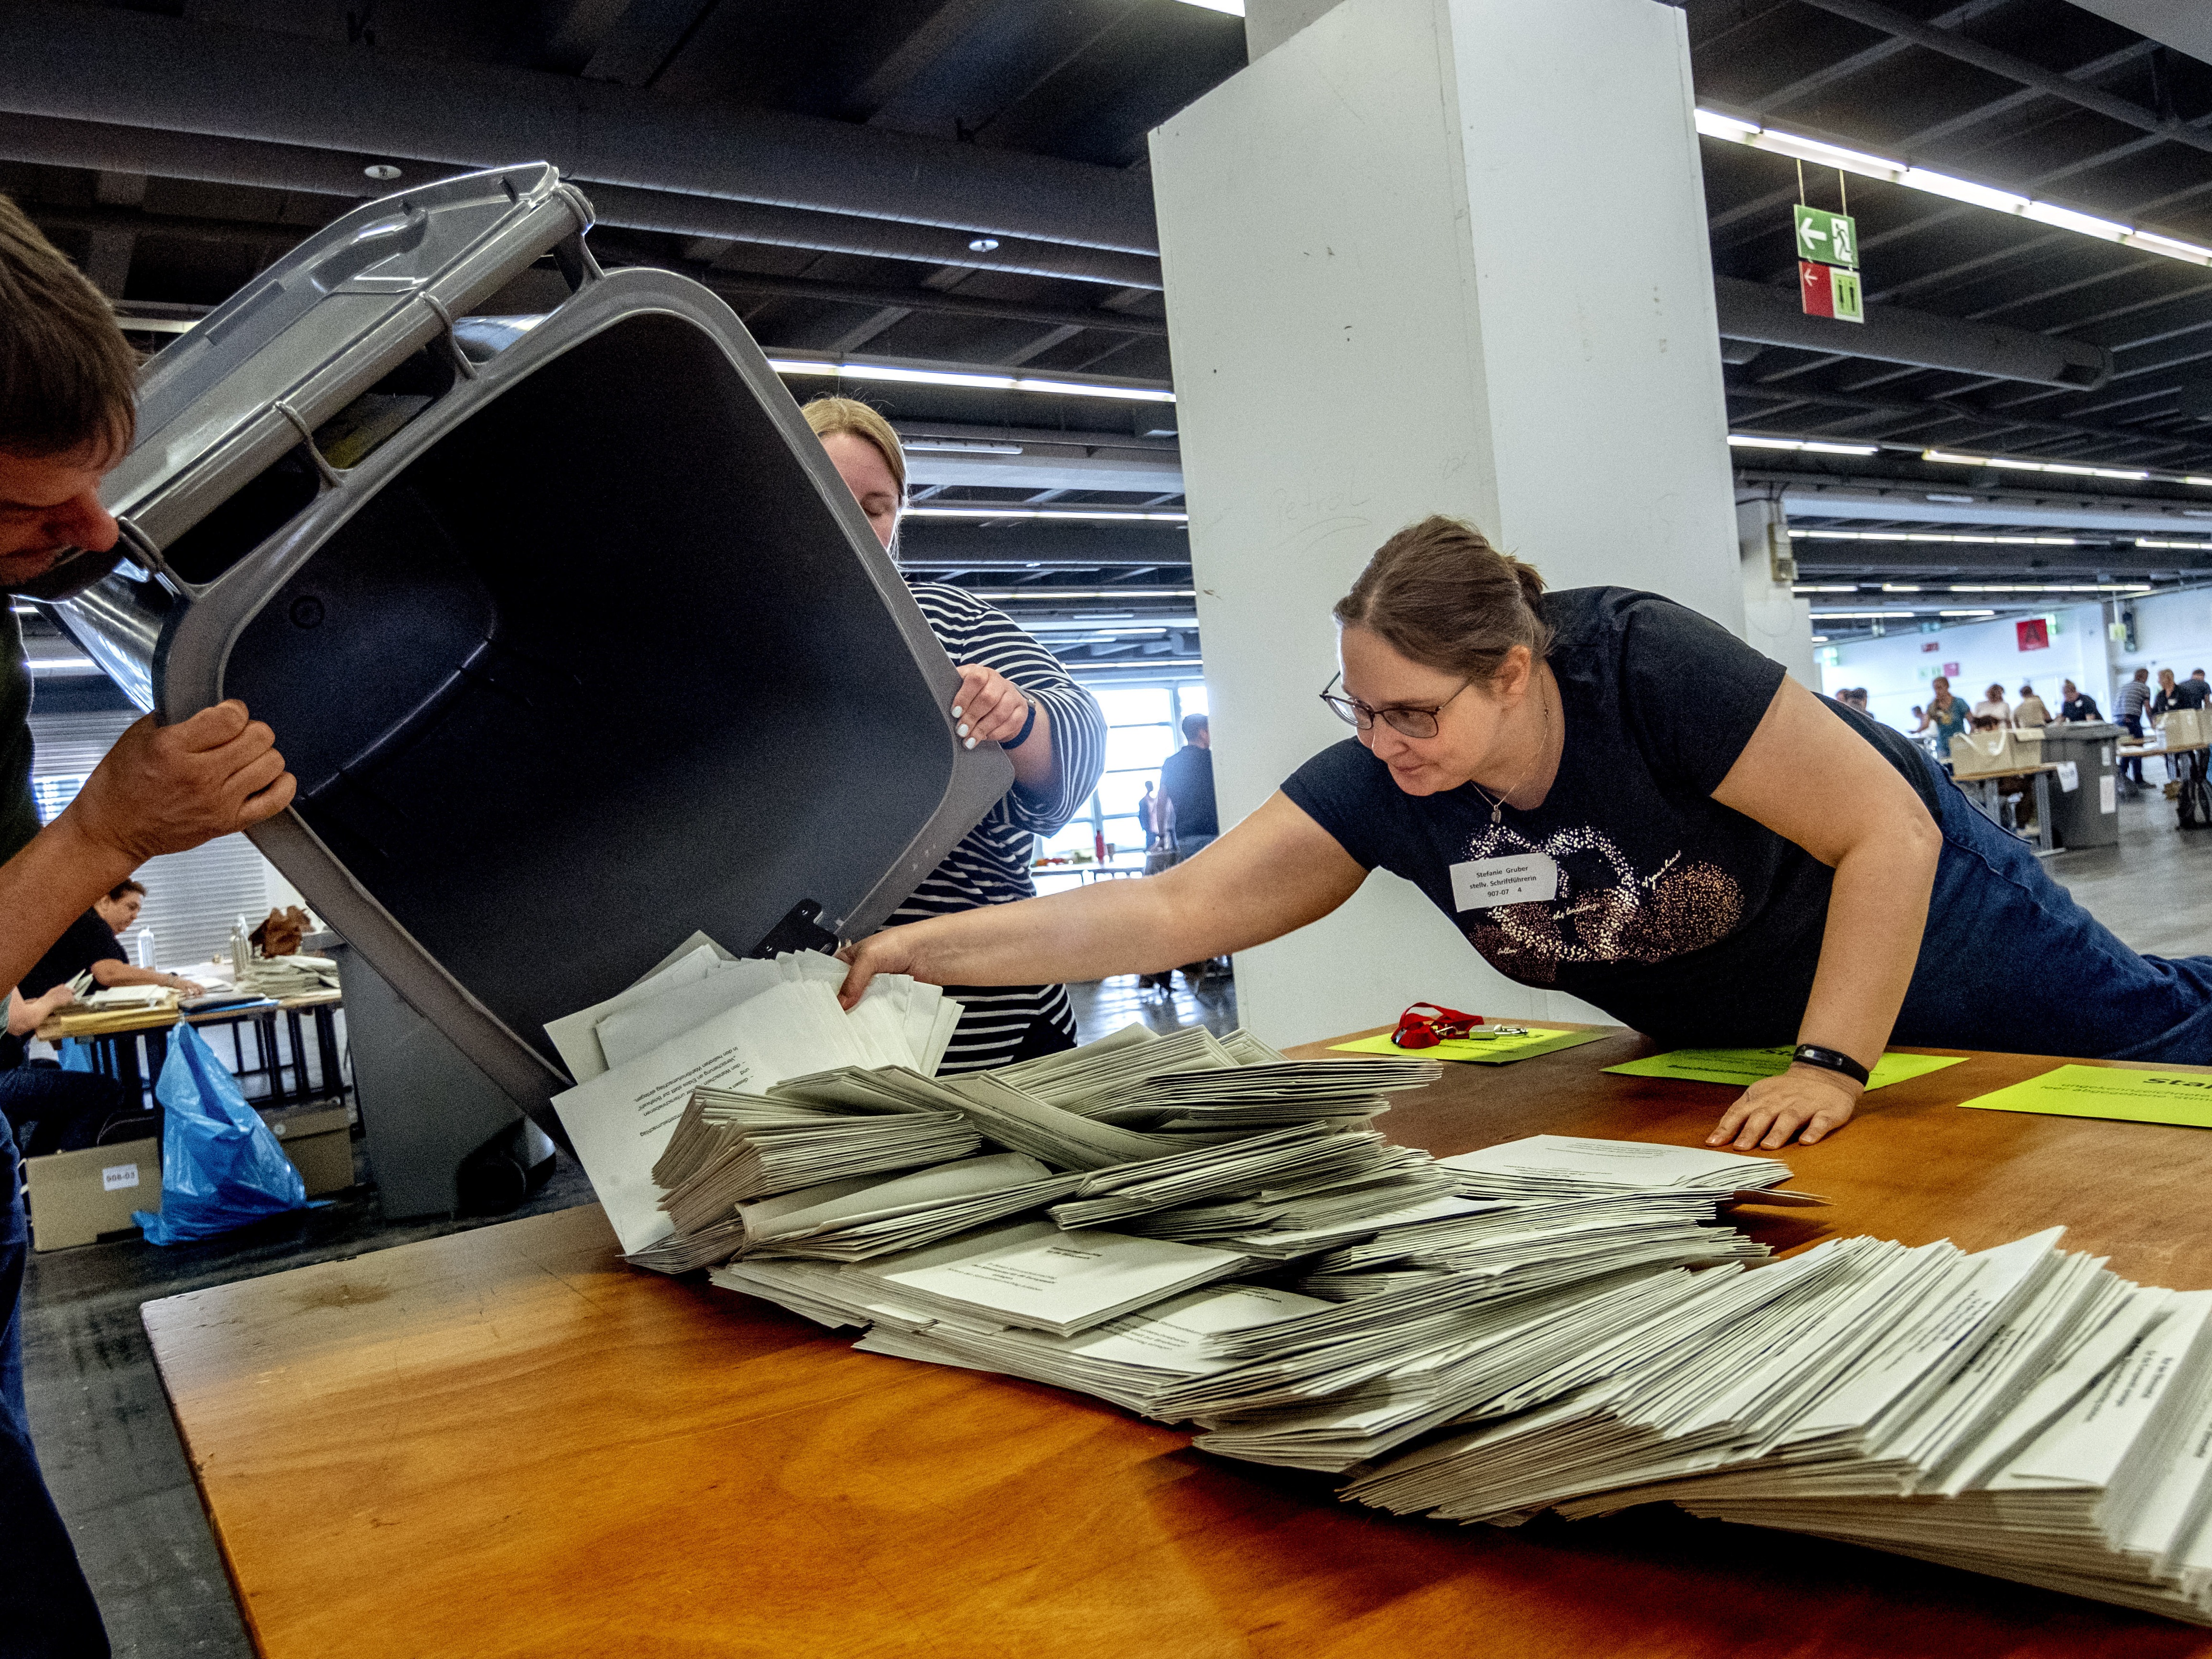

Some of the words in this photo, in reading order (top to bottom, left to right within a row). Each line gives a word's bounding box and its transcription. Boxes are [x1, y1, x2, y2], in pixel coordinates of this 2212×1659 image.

[1476, 869, 1503, 878] Stefanie
[1490, 875, 1537, 887] Schriftführerin
[704, 1069, 731, 1085] Wahlschein
[683, 1078, 697, 1087] Eides
